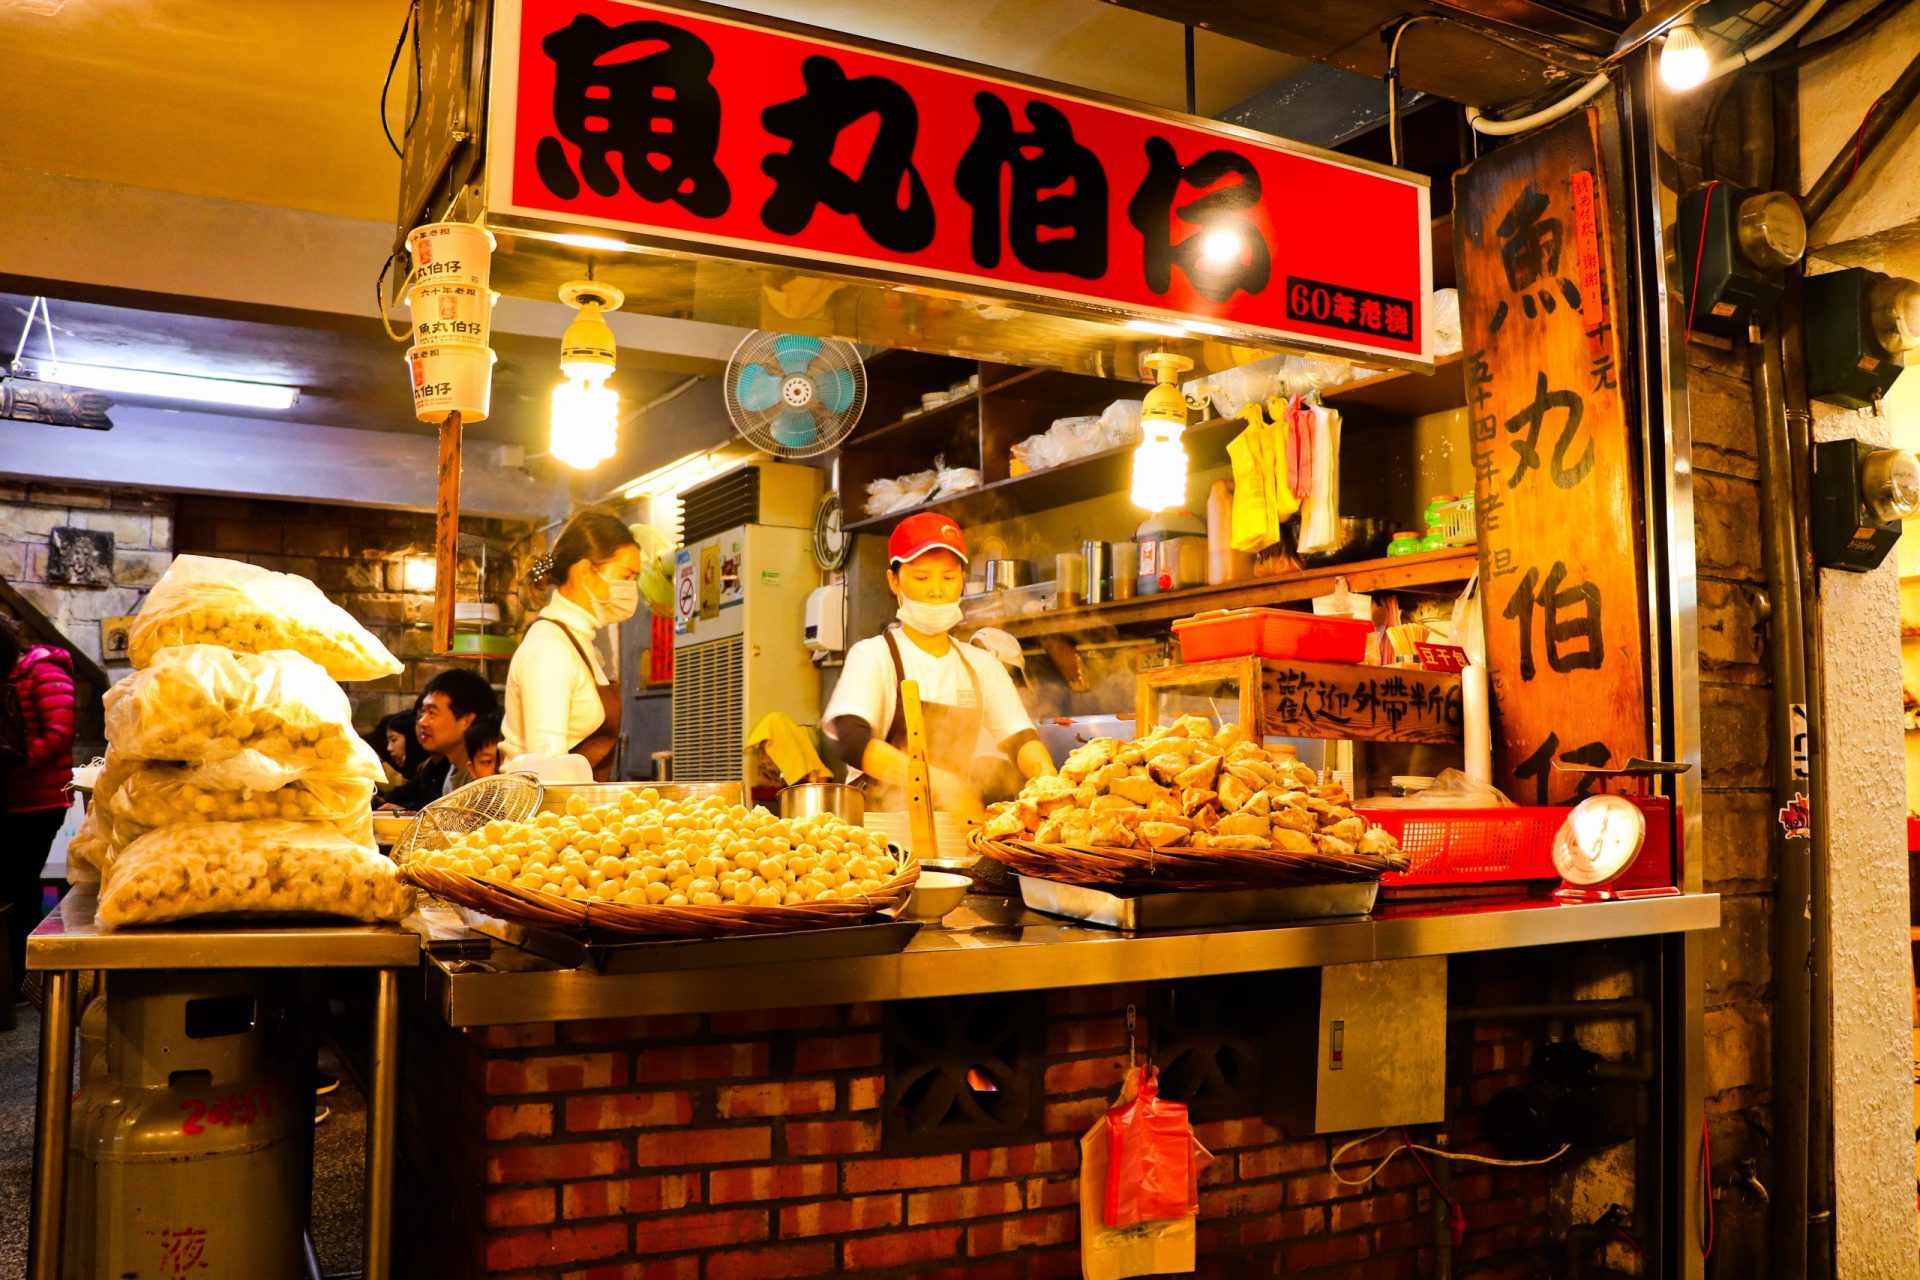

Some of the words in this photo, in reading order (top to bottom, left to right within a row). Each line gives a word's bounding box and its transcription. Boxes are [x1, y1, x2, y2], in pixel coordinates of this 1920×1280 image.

[535, 13, 1272, 303] 魚丸伯仔
[411, 228, 450, 242] 十年老担
[418, 320, 482, 336] 魚丸伯仔
[1419, 646, 1469, 667] 豆干包
[159, 1227, 209, 1280] 液
